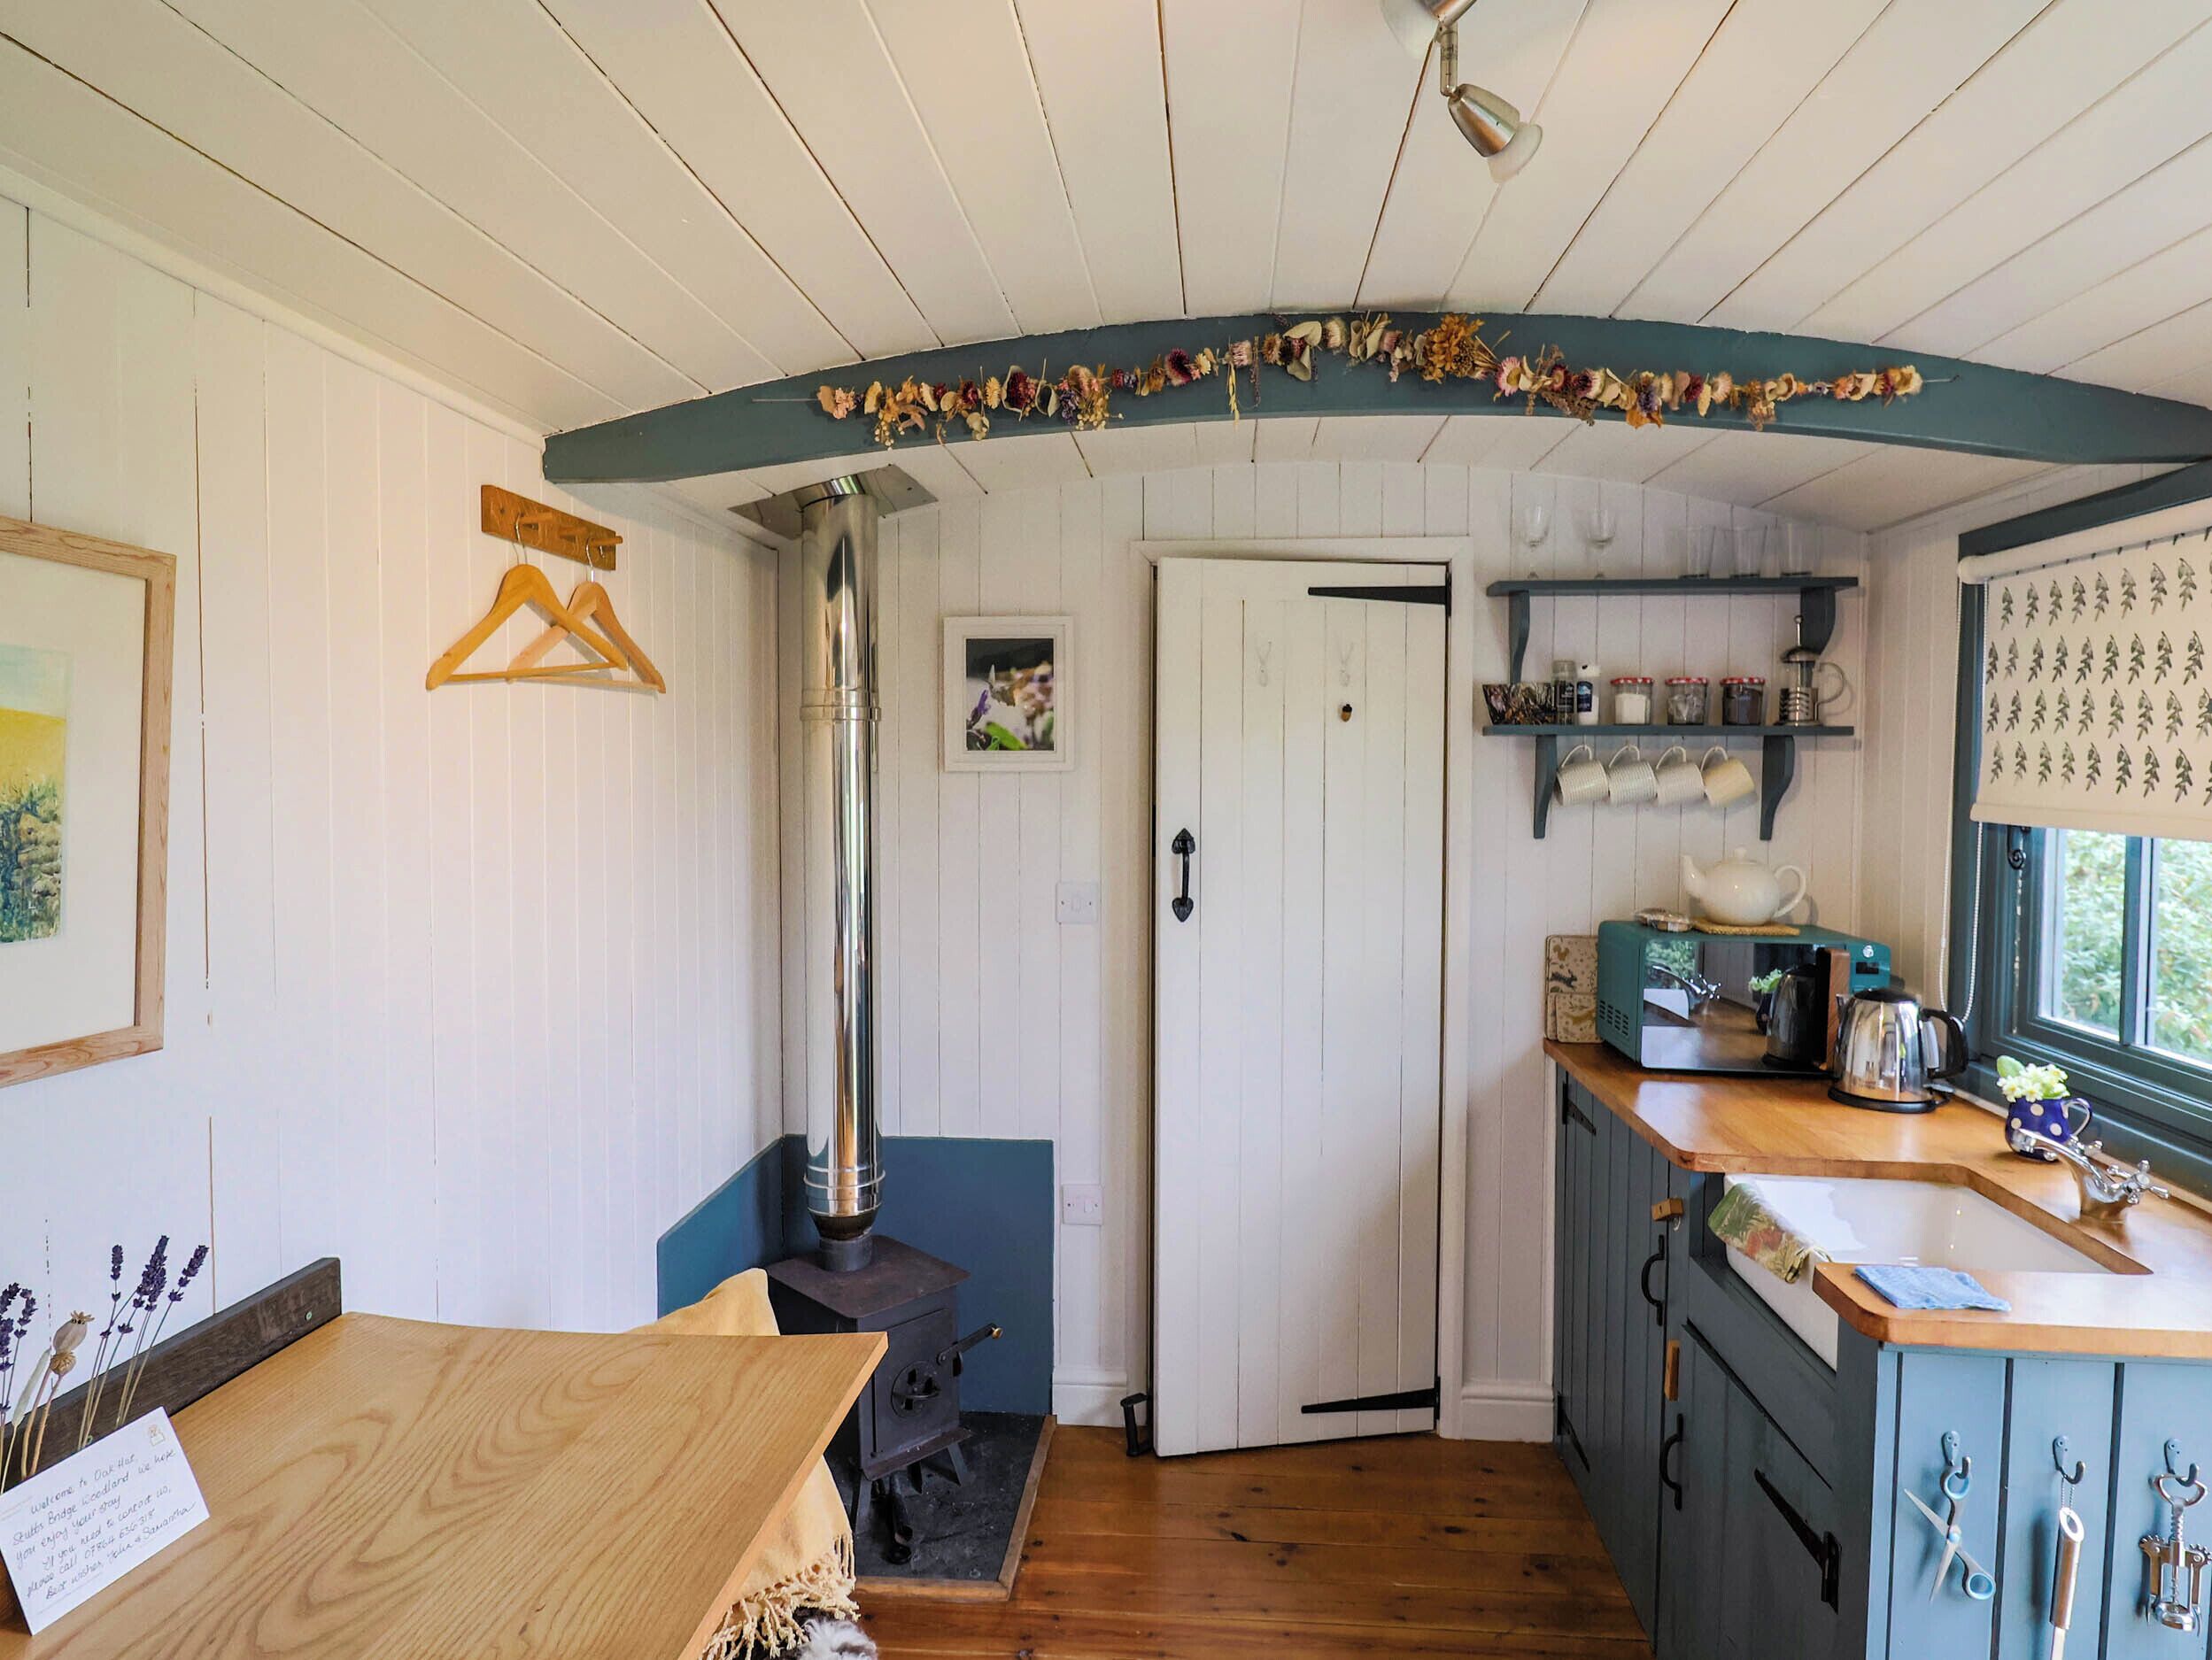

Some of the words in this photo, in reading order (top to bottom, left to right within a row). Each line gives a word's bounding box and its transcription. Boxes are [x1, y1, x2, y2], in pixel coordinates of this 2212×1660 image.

[30, 1487, 74, 1515] Welcome
[79, 1477, 88, 1487] to
[94, 1465, 113, 1481] Oak
[48, 1505, 77, 1524] Bridge
[82, 1471, 128, 1505] Woodland
[16, 1546, 35, 1571] you
[41, 1526, 68, 1550] enjoy
[72, 1508, 96, 1534] your
[58, 1545, 76, 1565] you
[81, 1525, 102, 1544] need
[106, 1517, 114, 1529] to
[118, 1494, 151, 1521] contact
[59, 1553, 78, 1574] call
